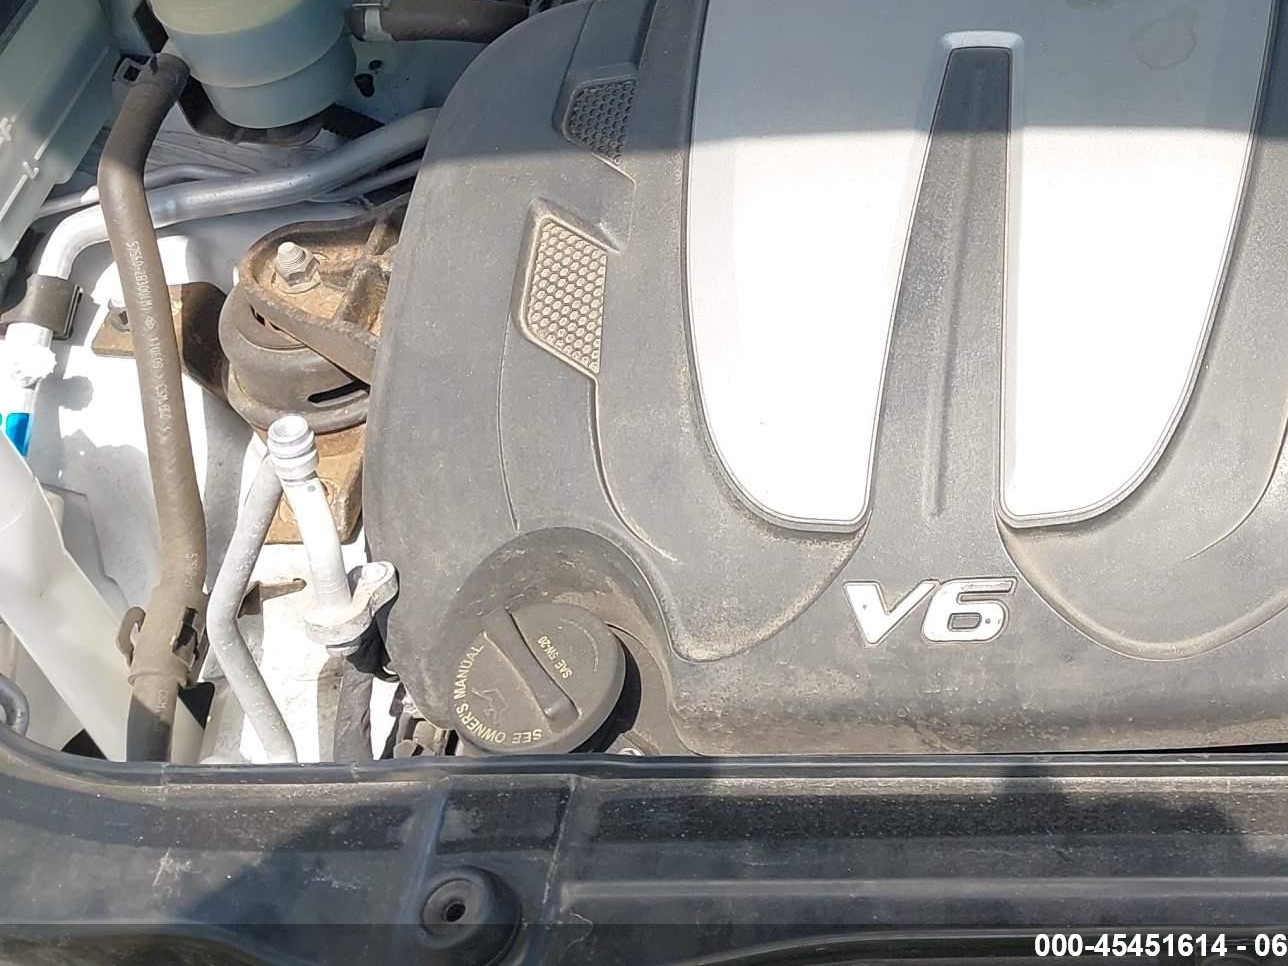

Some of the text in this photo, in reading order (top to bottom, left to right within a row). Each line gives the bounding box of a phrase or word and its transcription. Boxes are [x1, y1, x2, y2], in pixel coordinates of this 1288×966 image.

[844, 576, 1018, 644] V6
[537, 636, 573, 679] SAE 5W-20
[453, 644, 543, 744] SEE OWNER'S MANUAL
